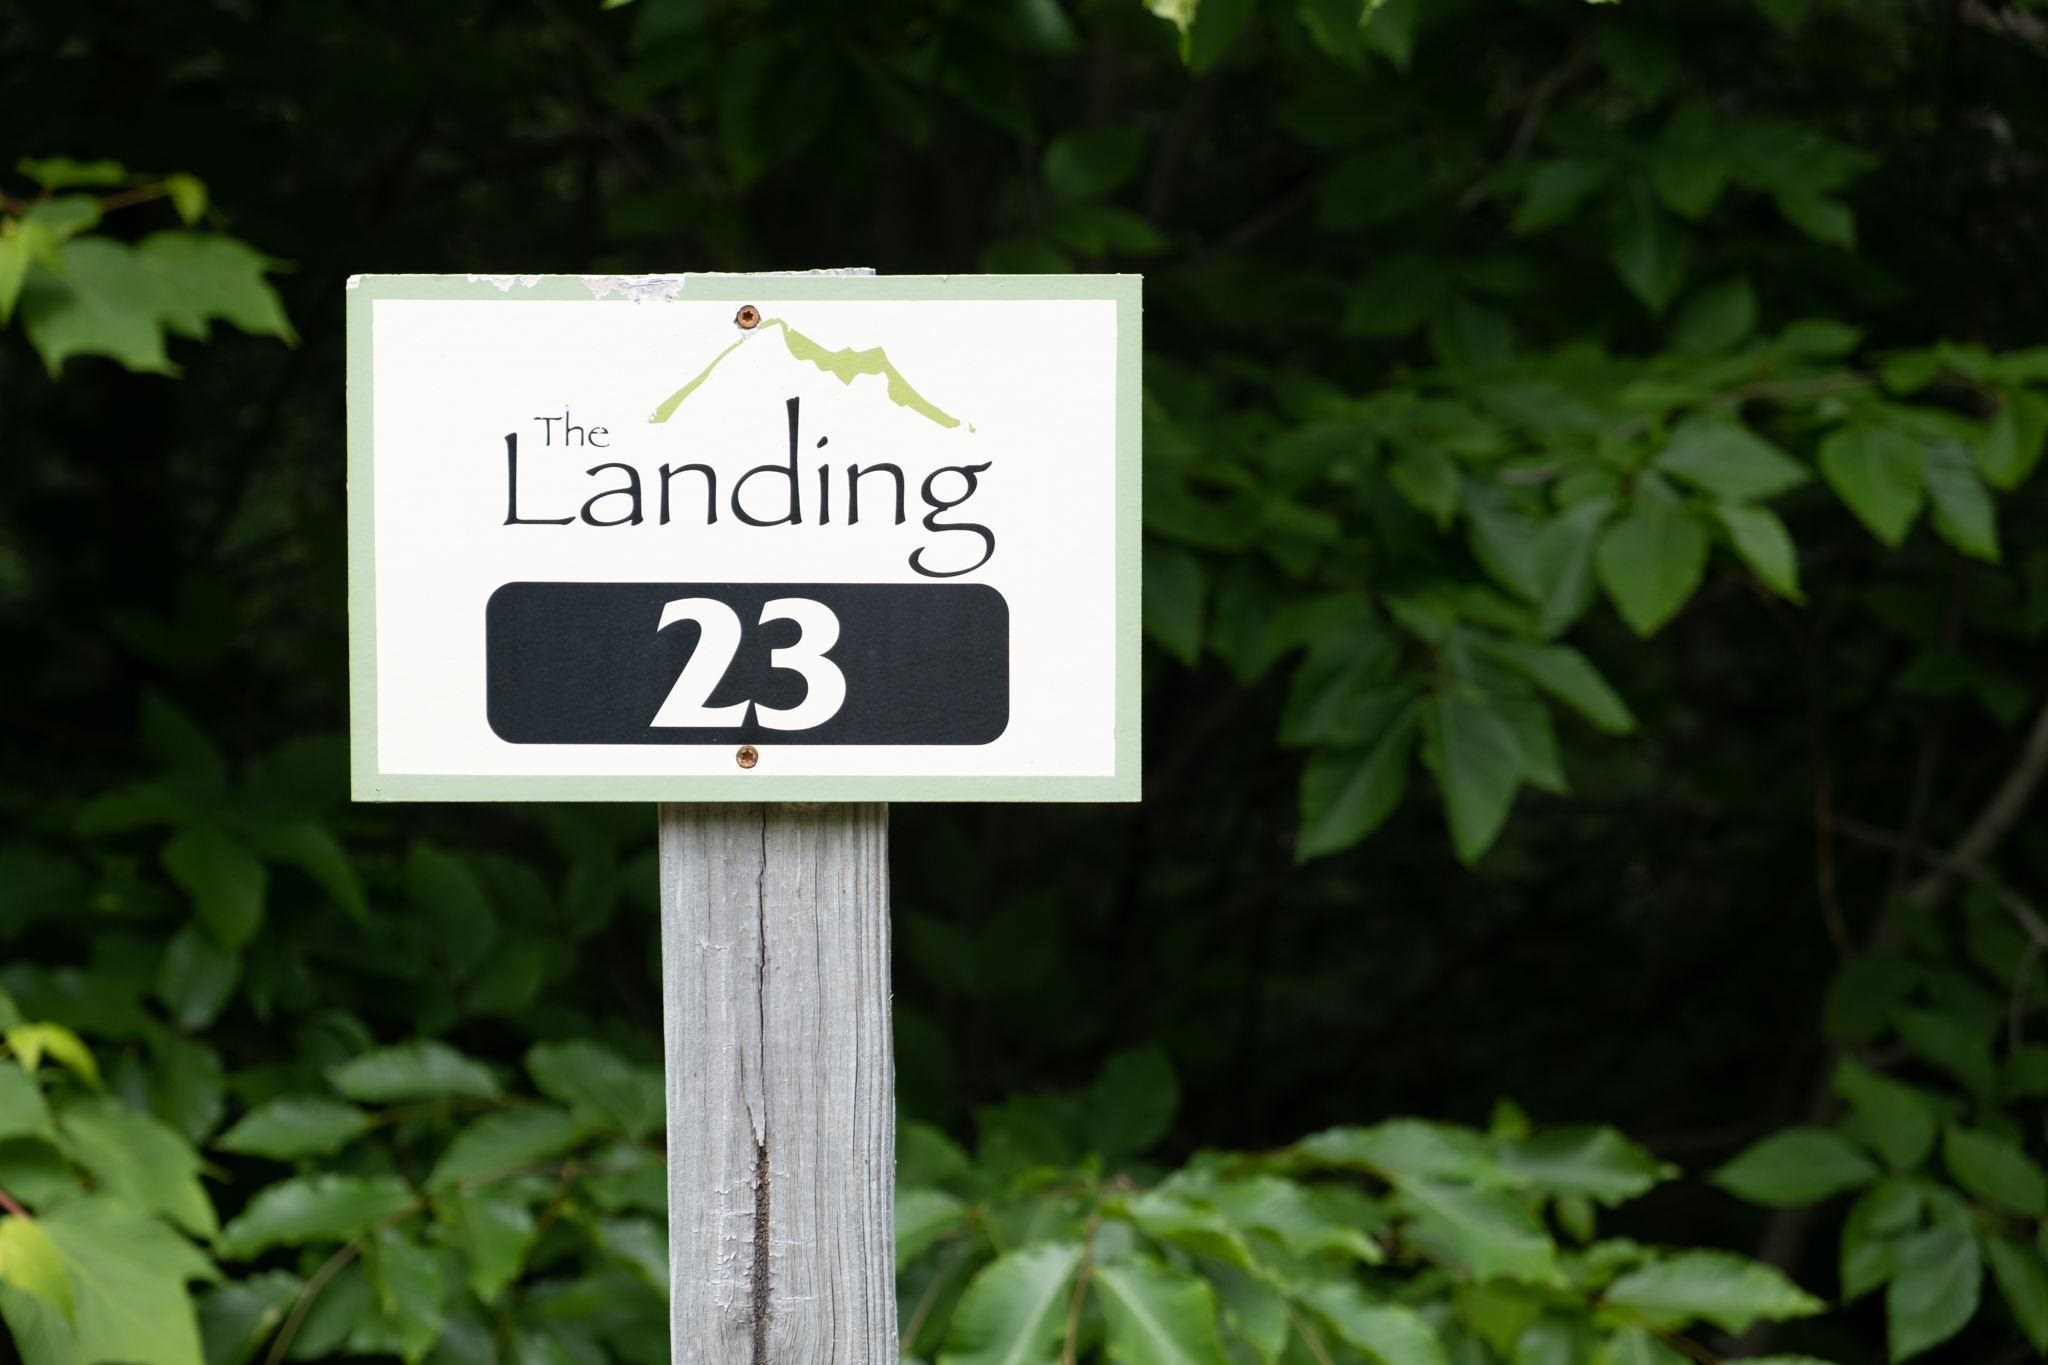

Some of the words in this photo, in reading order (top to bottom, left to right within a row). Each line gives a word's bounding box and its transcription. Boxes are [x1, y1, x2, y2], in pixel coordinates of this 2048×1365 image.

[503, 396, 997, 578] Landing
[534, 405, 610, 448] The
[649, 597, 847, 731] 23
